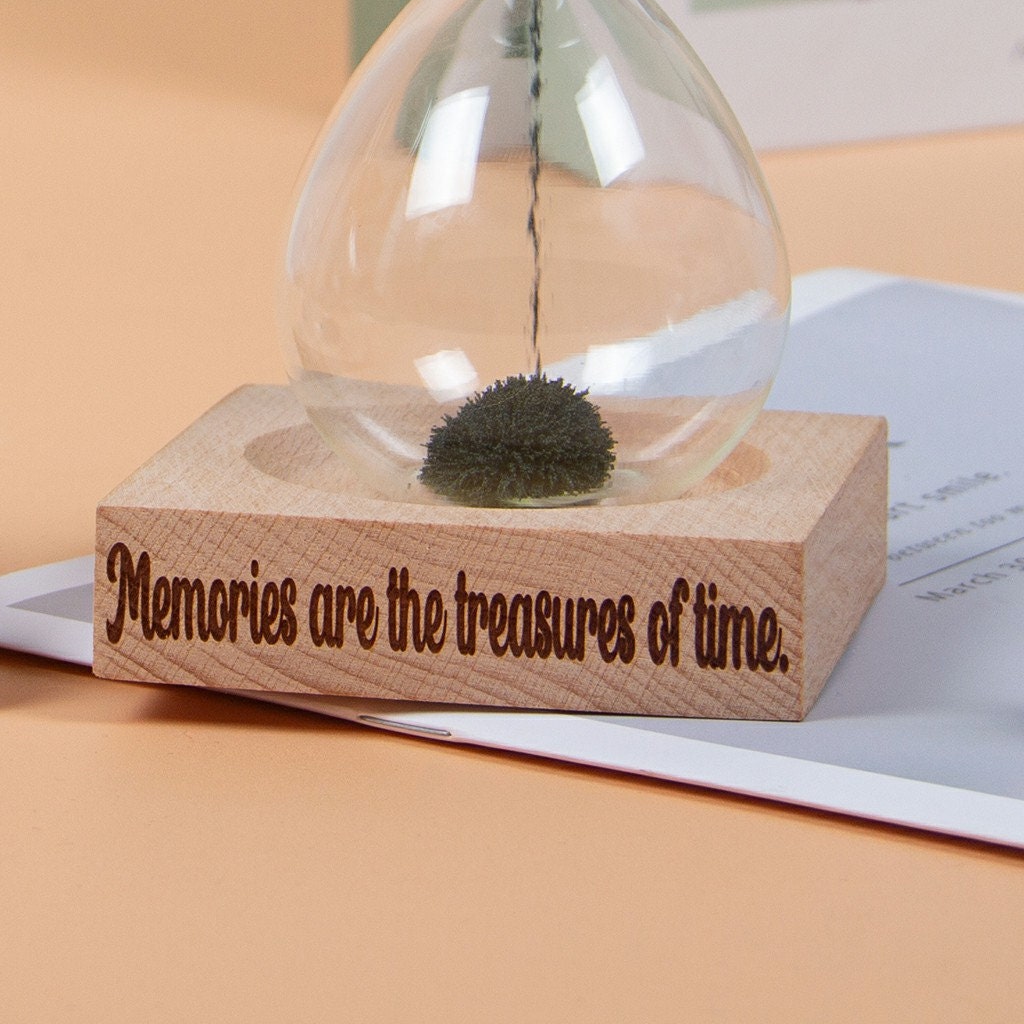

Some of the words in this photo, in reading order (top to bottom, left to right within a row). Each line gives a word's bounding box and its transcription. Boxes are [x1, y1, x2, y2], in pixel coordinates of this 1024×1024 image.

[105, 541, 299, 647] Memories
[308, 582, 380, 651] are
[385, 566, 448, 654] the
[453, 570, 636, 665] treasures
[647, 577, 690, 669] of
[692, 581, 790, 675] time.
[915, 572, 1008, 602] March
